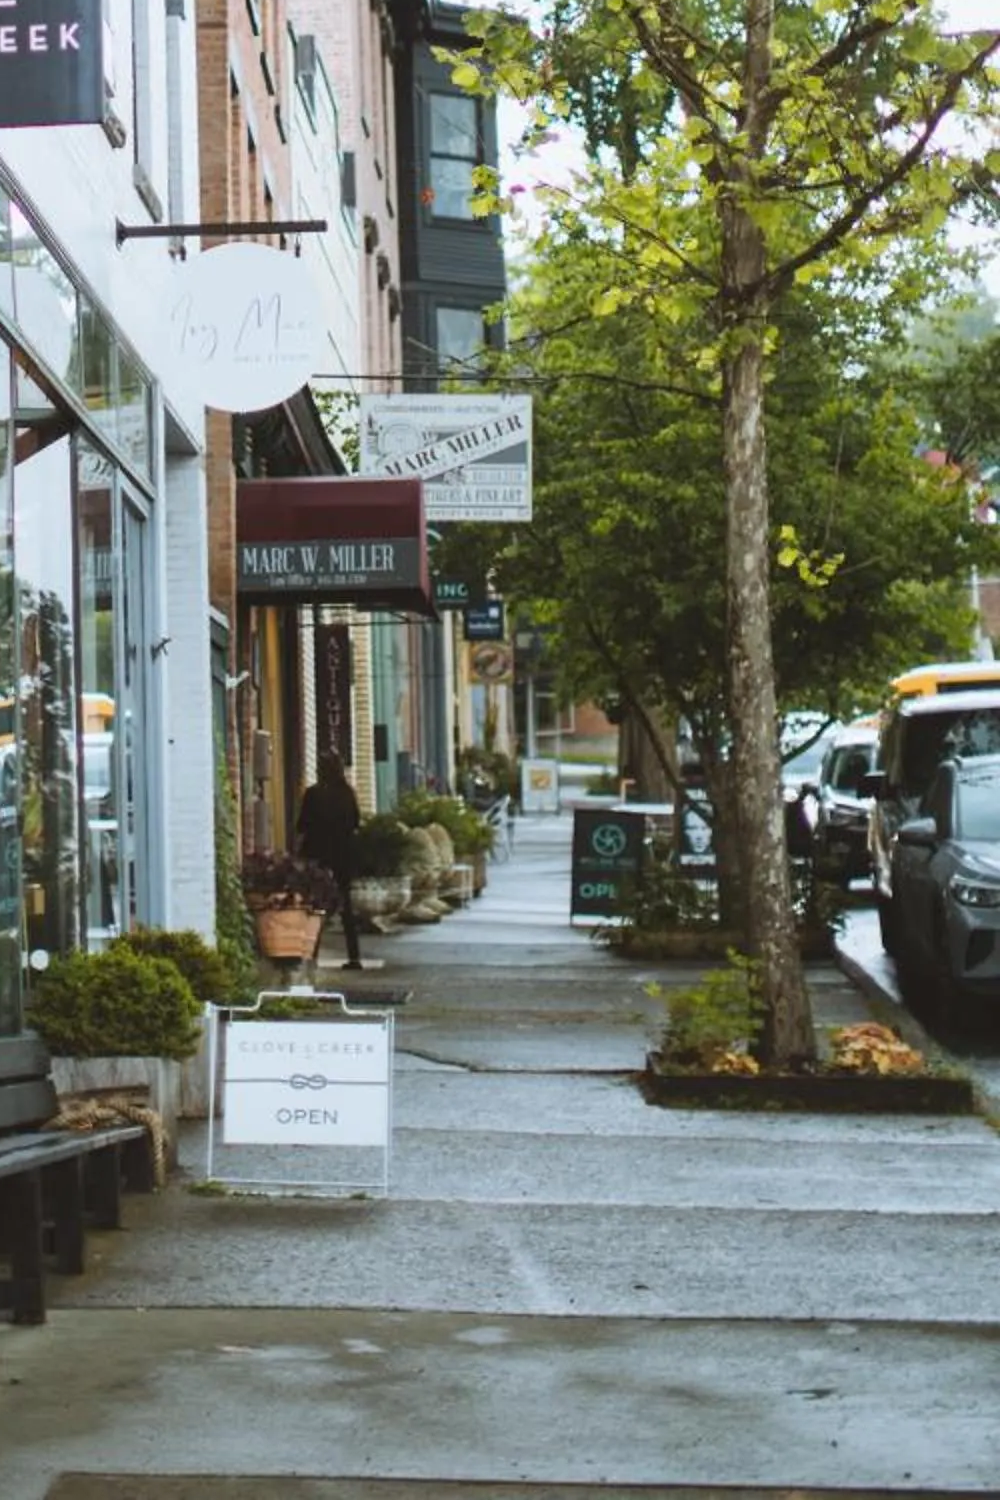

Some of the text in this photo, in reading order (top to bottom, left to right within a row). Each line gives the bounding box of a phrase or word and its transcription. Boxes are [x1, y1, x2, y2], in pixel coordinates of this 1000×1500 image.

[384, 414, 524, 476] MARC MILLER
[243, 544, 396, 574] MARC W. MILLER
[276, 1107, 338, 1125] OPEN
